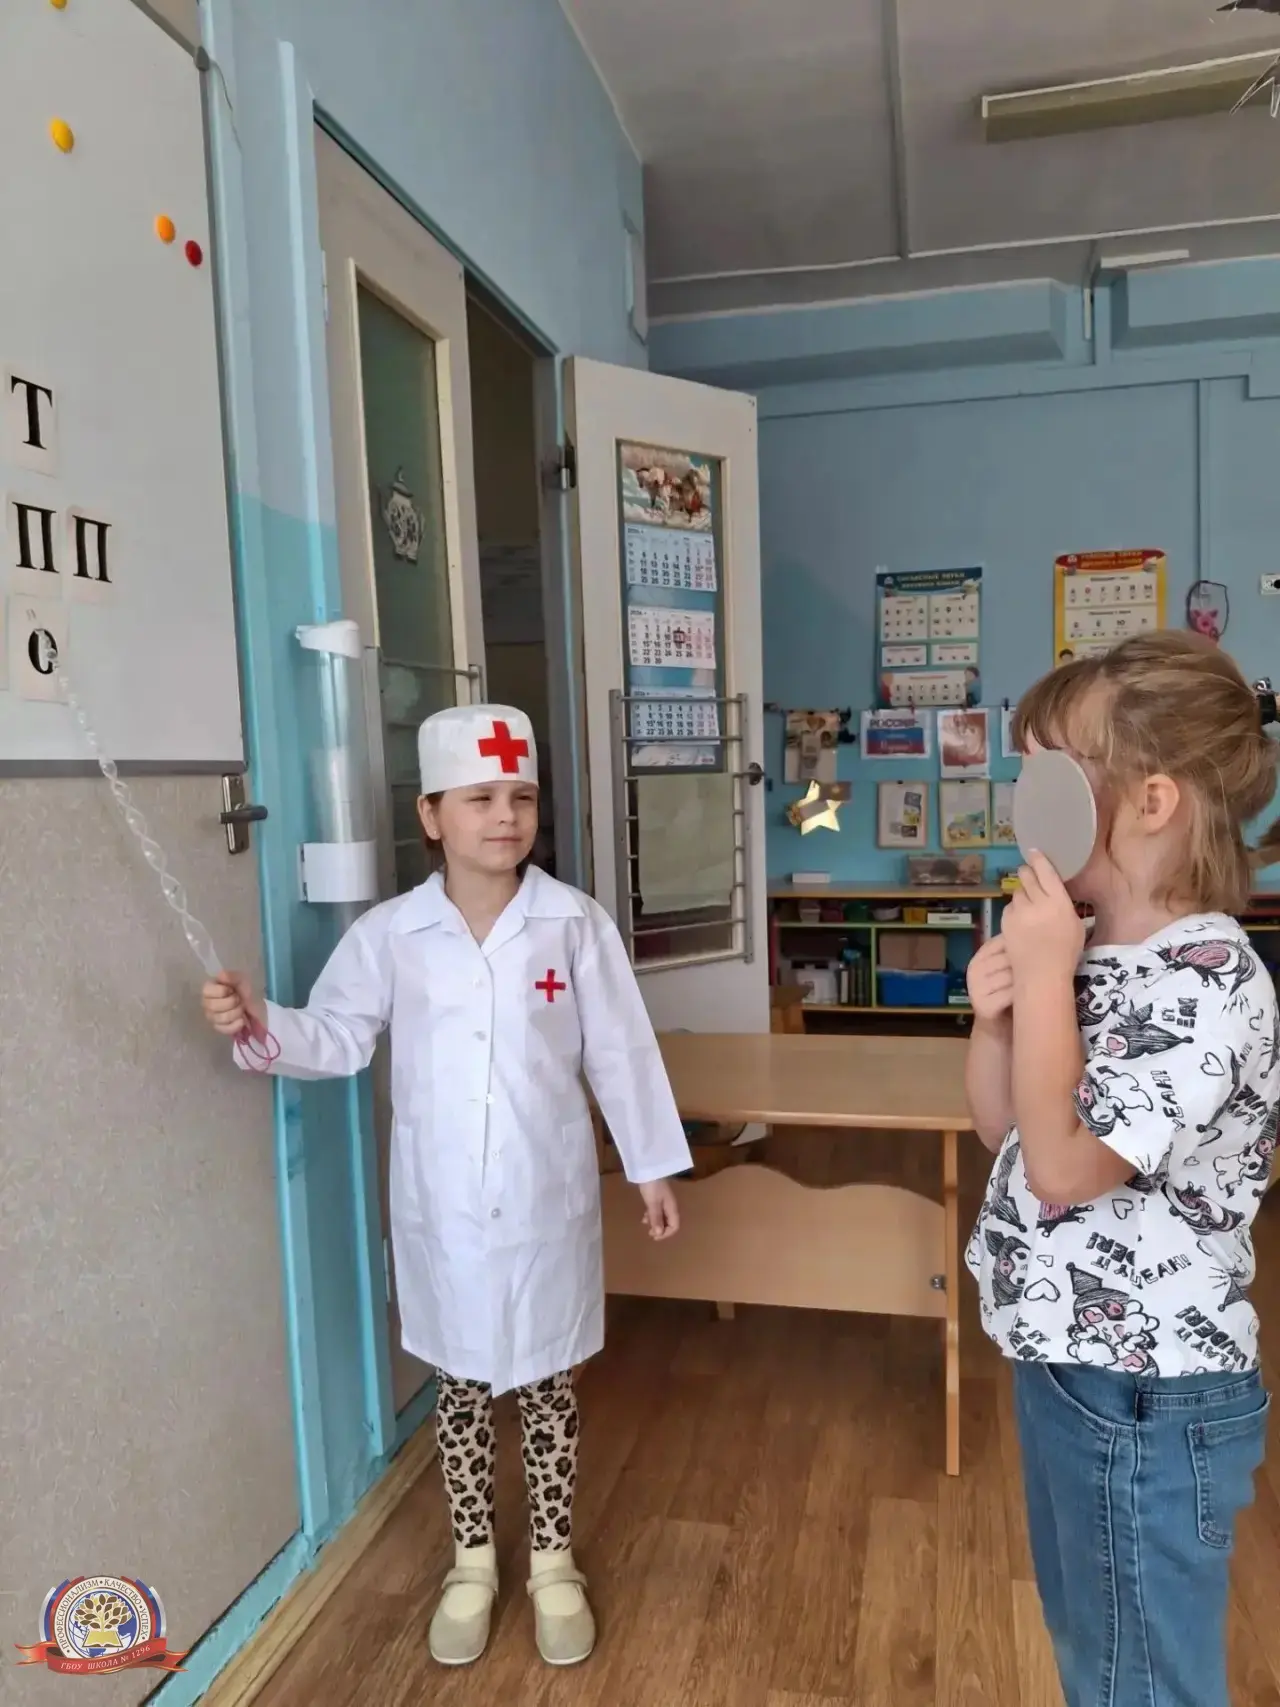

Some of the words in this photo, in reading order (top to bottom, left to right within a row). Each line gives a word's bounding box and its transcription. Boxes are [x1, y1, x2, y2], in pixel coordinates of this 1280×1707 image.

[11, 375, 53, 449] Т
[12, 501, 60, 574] П
[72, 514, 113, 583] П
[1150, 1070, 1185, 1131] YEAH!
[1132, 1254, 1192, 1290] YEAH!
